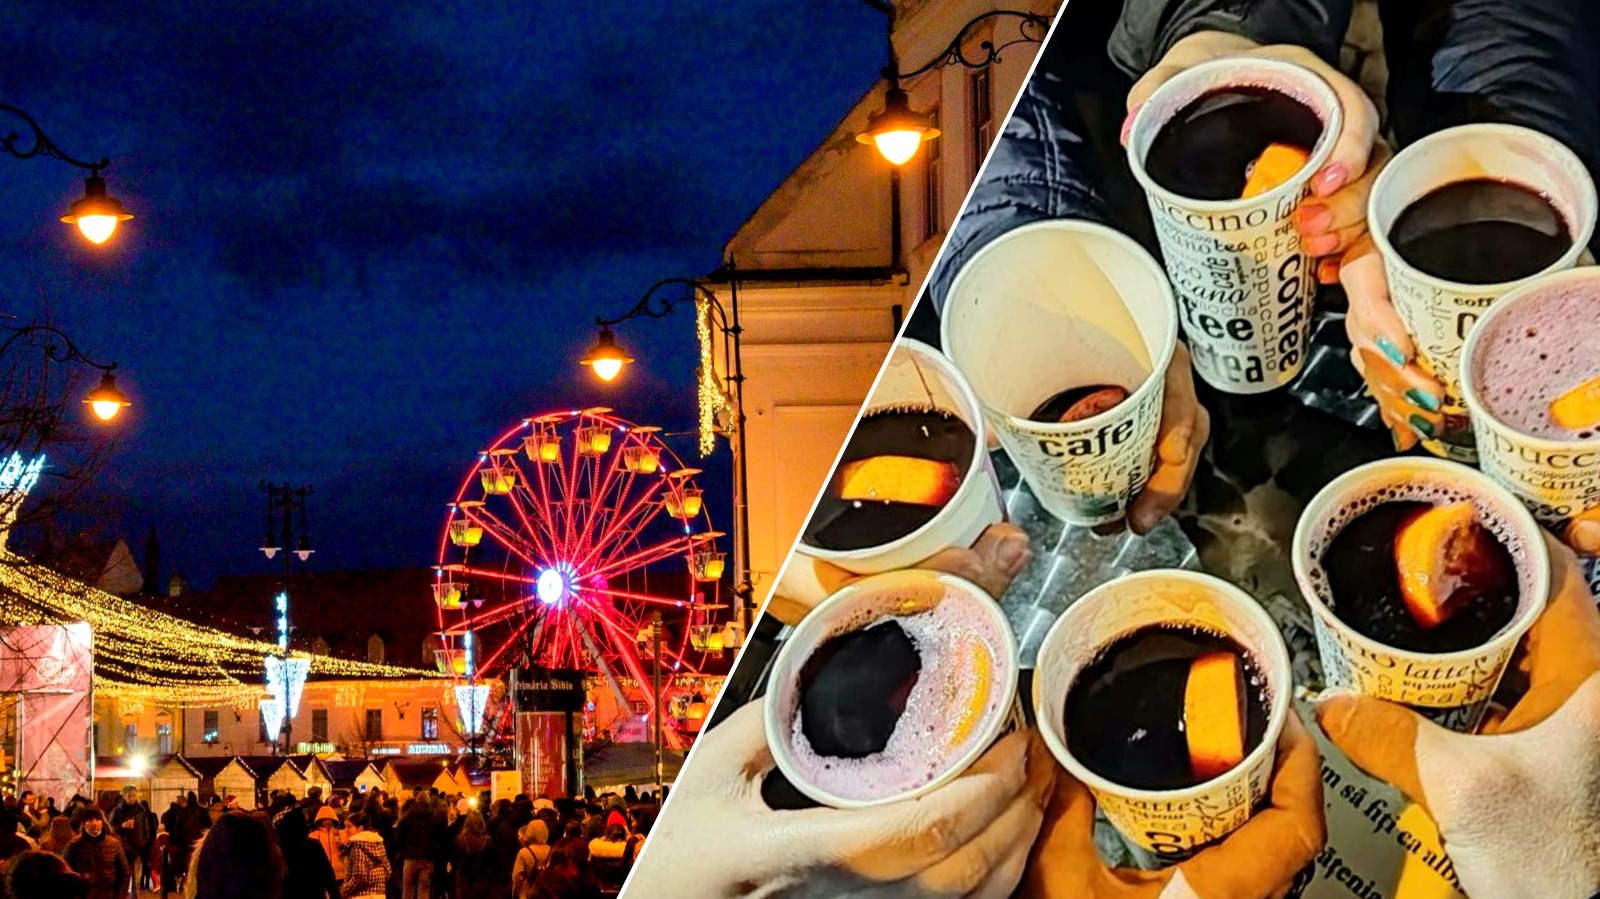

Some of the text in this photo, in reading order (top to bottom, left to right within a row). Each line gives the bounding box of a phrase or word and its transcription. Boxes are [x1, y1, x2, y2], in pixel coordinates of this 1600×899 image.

[1250, 235, 1278, 372] cappuccino
[1277, 252, 1304, 372] coffee
[1038, 418, 1134, 458] cafe
[1403, 661, 1471, 681] latte
[550, 678, 574, 691] Sibiu
[407, 744, 452, 755] ADMIRAL
[1396, 829, 1423, 855] ca
